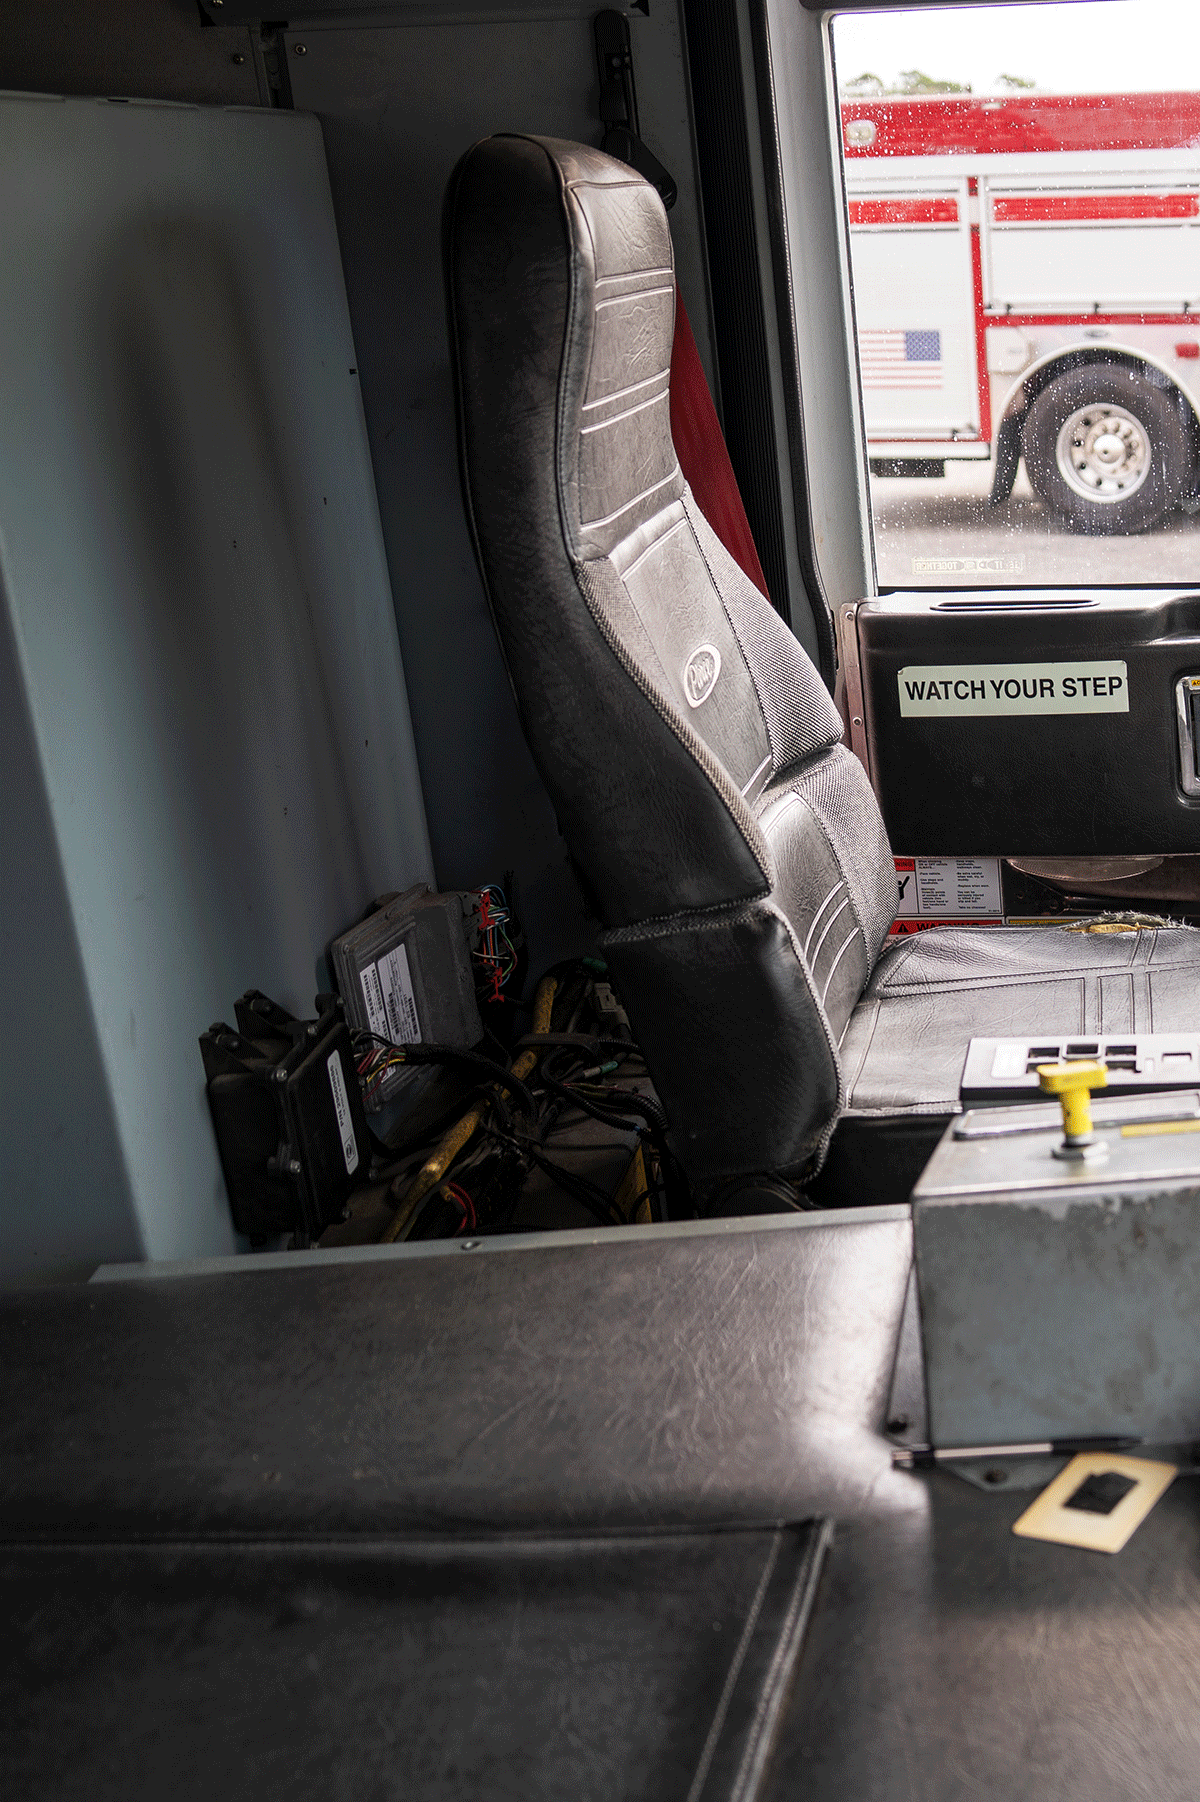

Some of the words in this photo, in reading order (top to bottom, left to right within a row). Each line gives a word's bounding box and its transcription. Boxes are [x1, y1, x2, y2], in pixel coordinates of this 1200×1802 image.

[904, 680, 986, 700] WATCH
[990, 678, 1055, 699] YOUR
[1062, 676, 1123, 698] STEP
